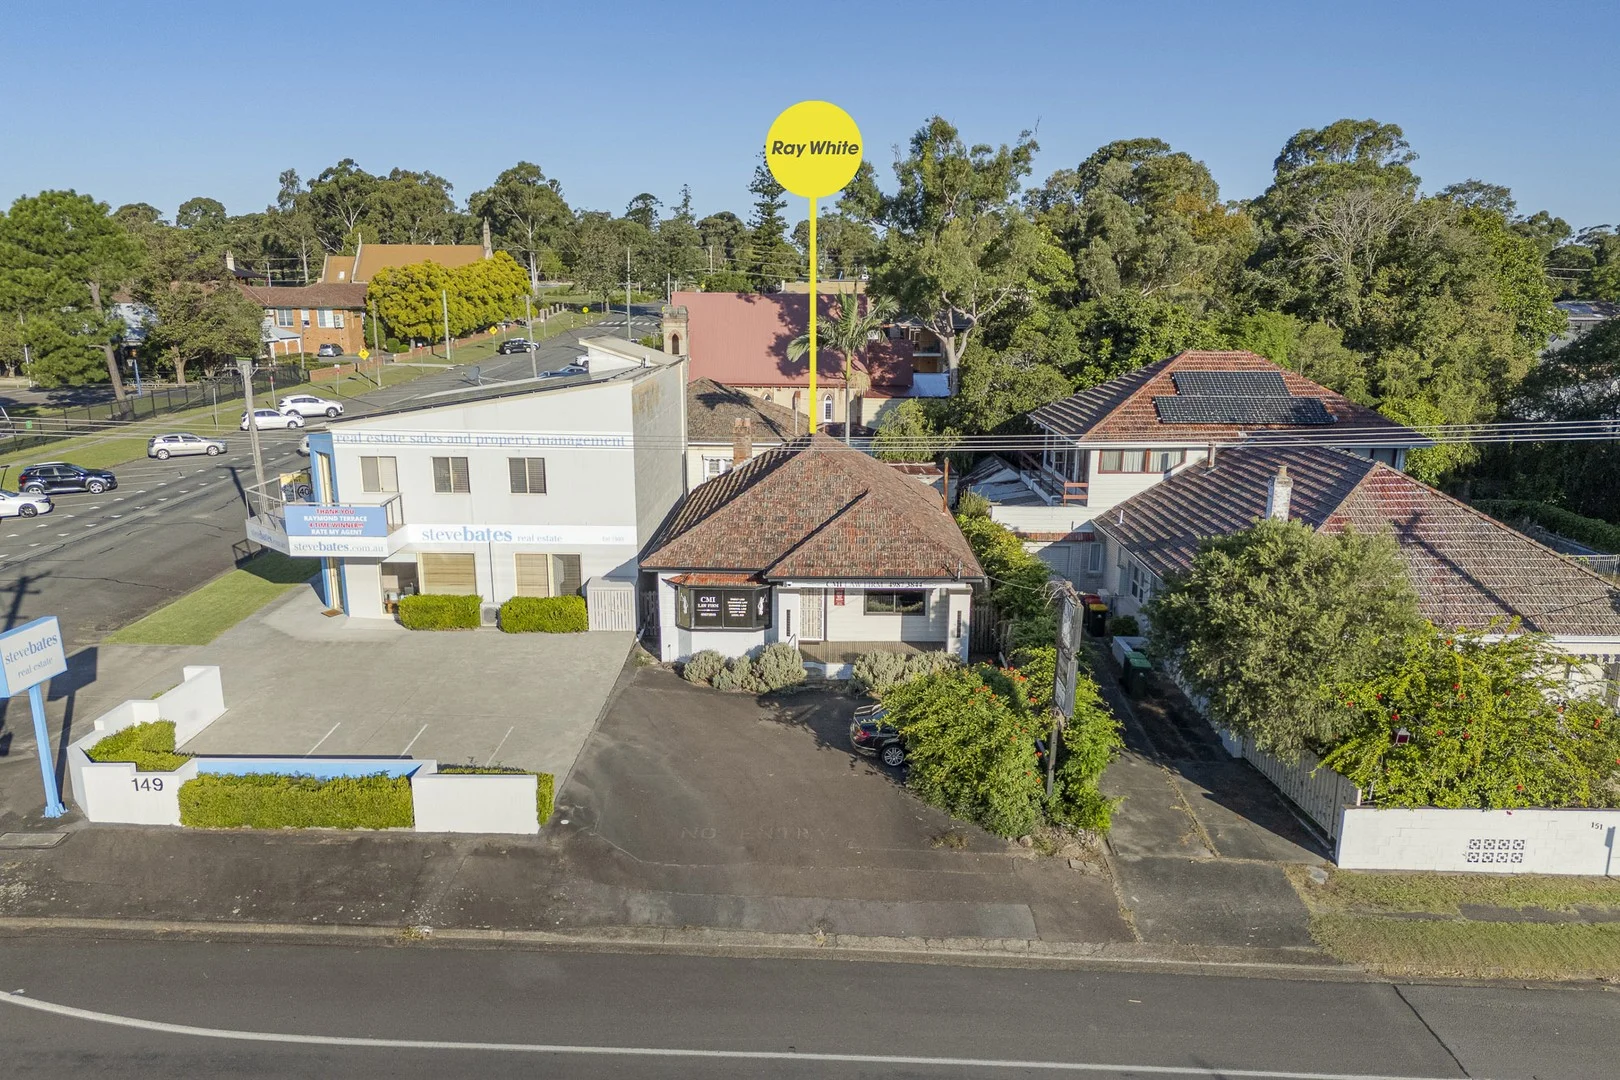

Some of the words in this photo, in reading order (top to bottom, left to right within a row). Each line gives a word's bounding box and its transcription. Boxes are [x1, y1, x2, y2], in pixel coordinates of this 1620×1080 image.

[336, 432, 361, 443] real
[367, 433, 405, 444] estate
[410, 433, 443, 444] sales
[447, 434, 471, 445] and
[476, 435, 534, 447] property
[538, 436, 625, 448] management
[299, 488, 310, 496] 40
[422, 526, 513, 542] stevebates
[517, 534, 535, 542] real
[537, 534, 563, 542] estate
[293, 541, 384, 552] stevebates.com.au
[5, 634, 58, 665] stevebates
[18, 665, 33, 678] real
[33, 657, 52, 671] estate
[131, 777, 164, 791] 149
[681, 826, 717, 839] NO
[1591, 821, 1603, 830] 151
